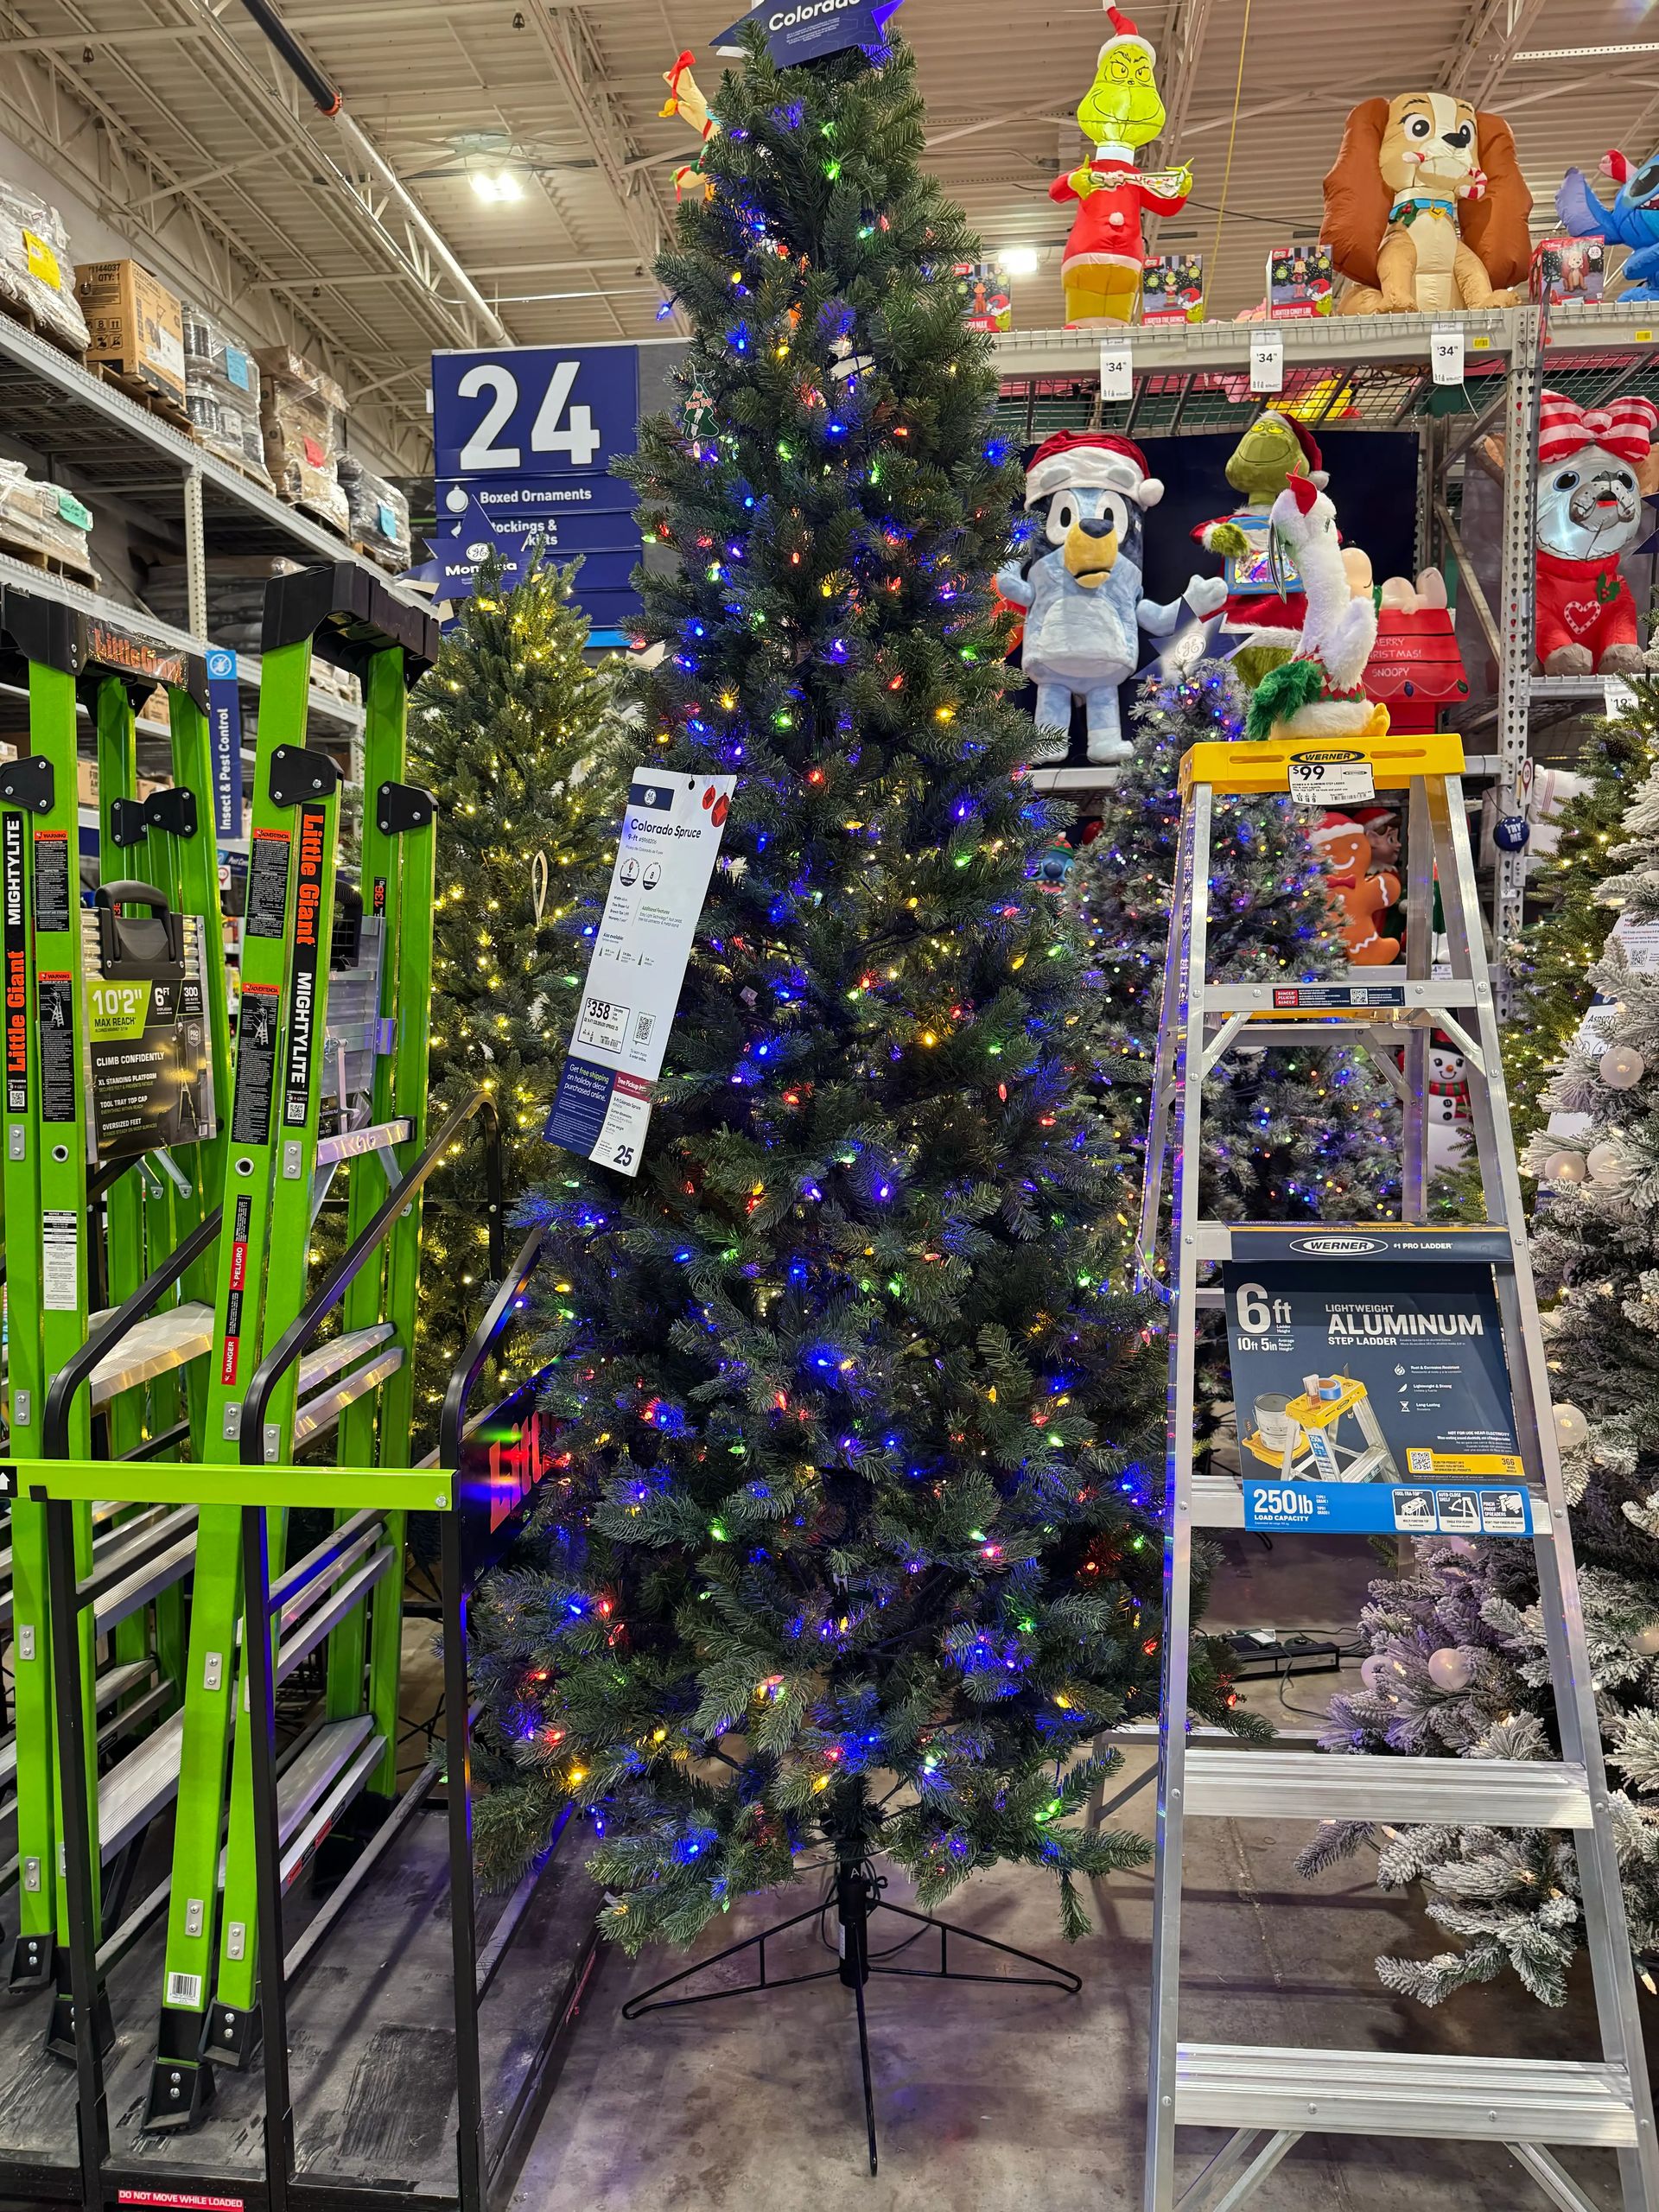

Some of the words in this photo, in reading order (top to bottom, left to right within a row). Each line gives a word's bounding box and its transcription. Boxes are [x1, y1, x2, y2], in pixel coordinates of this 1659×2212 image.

[457, 361, 601, 471] 24
[480, 490, 519, 505] Boxed
[521, 487, 593, 503] Ornaments
[493, 520, 545, 535] tockings
[548, 518, 558, 531] &
[1372, 667, 1410, 677] SNOOPY
[217, 707, 230, 753] Control
[1305, 753, 1351, 761] WERNER
[219, 755, 232, 781] Pest
[1293, 765, 1325, 781] $99
[219, 783, 232, 792] &
[219, 794, 232, 830] Insect
[261, 831, 290, 840] ADVERTENCIA
[630, 817, 673, 836] Colorado
[674, 824, 702, 840] Spruce
[1506, 823, 1522, 834] TRY
[300, 813, 324, 876] Little
[627, 832, 639, 842] 9-ft
[1509, 832, 1522, 843] ME
[7, 820, 21, 925] MIGHTYLITE
[296, 882, 321, 946] Giant
[7, 950, 25, 1008] Giant
[183, 986, 199, 997] 300
[587, 999, 611, 1020] $358
[94, 1018, 111, 1027] MAX
[290, 971, 313, 1084] MIGHTYLITE
[8, 1014, 27, 1072] Little
[96, 1056, 119, 1067] CLIMB
[120, 1051, 165, 1065] CONFIDENTLY
[105, 1075, 132, 1086] STANDING
[132, 1072, 157, 1083] PLATFORM
[569, 1064, 580, 1073] Get
[579, 1067, 589, 1077] free
[588, 1071, 610, 1085] shipping
[574, 1074, 593, 1089] holiday
[563, 1082, 590, 1098] purchased
[617, 1077, 626, 1086] Tree
[625, 1078, 639, 1091] Pickup
[99, 1099, 114, 1109] TOOL
[114, 1097, 127, 1107] TRAY
[127, 1096, 138, 1105] TOP
[137, 1095, 148, 1103] CAP
[102, 1119, 130, 1131] OVERSIZED
[130, 1117, 142, 1126] FEET
[613, 1144, 635, 1166] 25
[1310, 1242, 1370, 1250] WERNER
[233, 1246, 244, 1281] PELIGRO
[1325, 1304, 1395, 1313] LIGHTWEIGHT
[1327, 1313, 1484, 1336] ALUMINUM
[1327, 1337, 1354, 1346] STEP
[1356, 1337, 1397, 1346] LADDER
[225, 1340, 235, 1374] DANGER
[1501, 1458, 1515, 1466] 366
[850, 1867, 861, 1878] A
[118, 2190, 132, 2199] DO
[133, 2191, 151, 2201] NOT
[152, 2192, 178, 2202] MOVE
[179, 2195, 207, 2205] WHILE
[208, 2198, 244, 2208] LOADED
